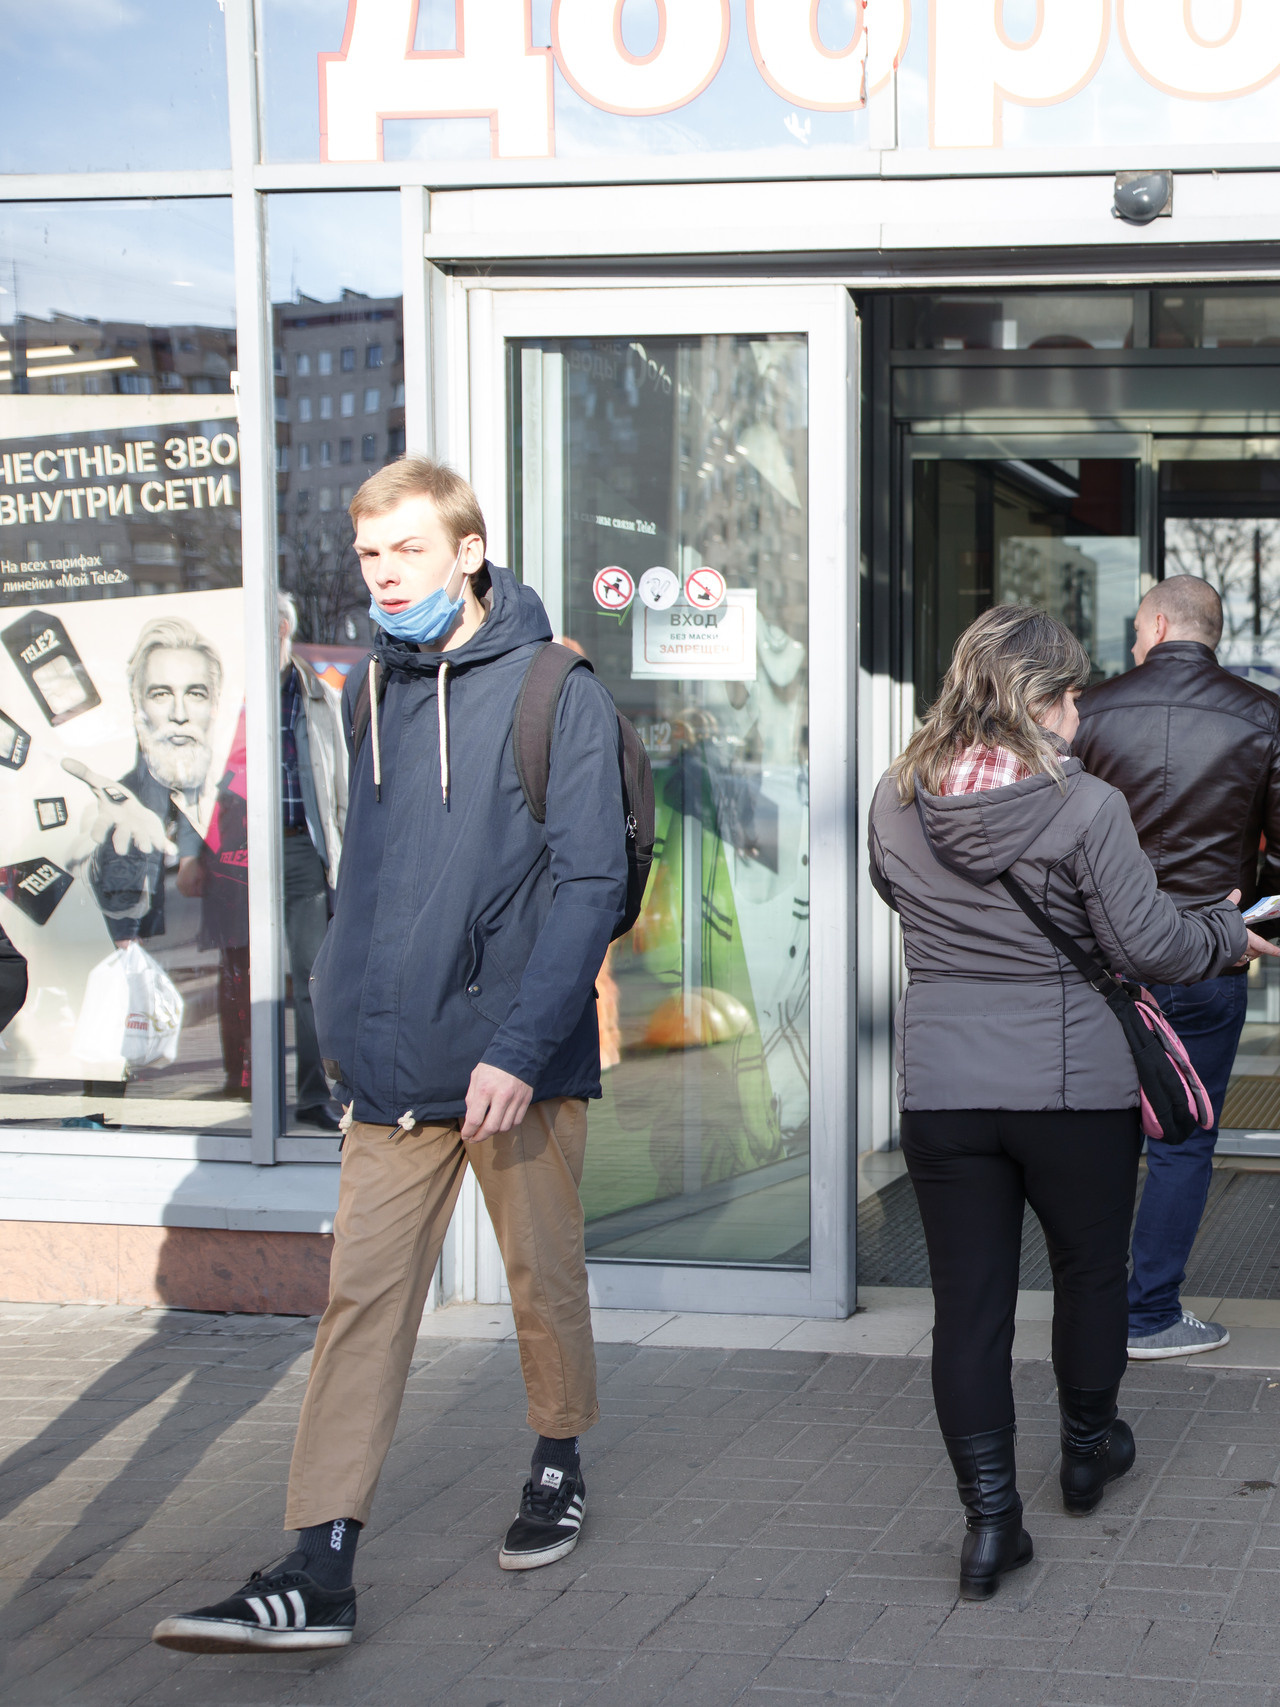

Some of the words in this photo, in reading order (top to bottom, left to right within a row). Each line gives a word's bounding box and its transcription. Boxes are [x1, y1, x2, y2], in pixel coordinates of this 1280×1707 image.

[163, 431, 241, 471] ЗВО
[0, 484, 134, 526] ВНУТРИ
[140, 474, 233, 513] СЕТИ
[1, 560, 18, 574] На
[20, 561, 48, 572] всех
[49, 554, 103, 572] тарифах
[3, 577, 54, 592] линейки
[670, 614, 718, 628] ВХОД
[20, 628, 62, 664] TELE2
[689, 633, 719, 641] МАСКИ
[18, 864, 62, 896] TELE2
